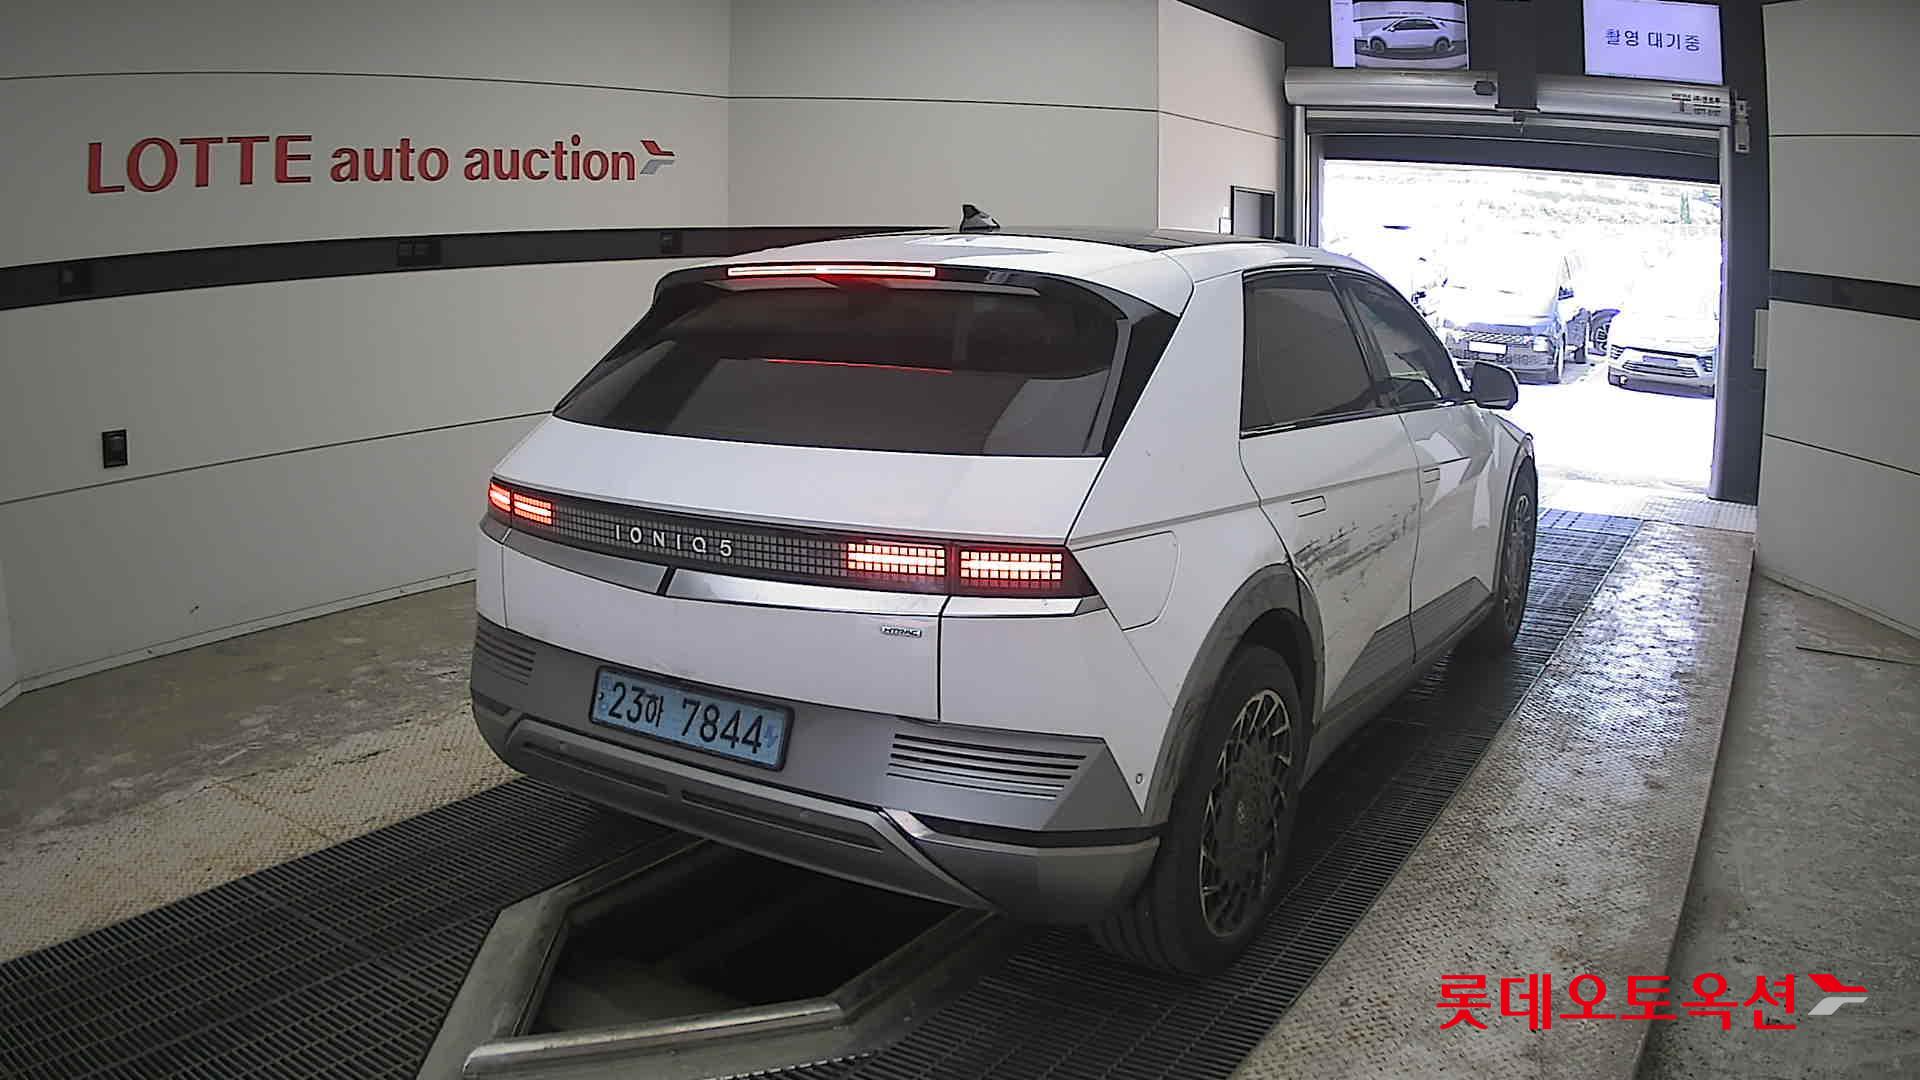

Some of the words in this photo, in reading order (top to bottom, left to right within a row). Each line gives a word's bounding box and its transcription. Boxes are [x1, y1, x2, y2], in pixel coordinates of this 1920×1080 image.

[88, 135, 313, 193] LOTTE
[330, 137, 449, 183] auto
[464, 135, 637, 181] auction
[615, 524, 707, 554] IONIQ
[719, 540, 733, 557] 5
[681, 697, 764, 754] 7844
